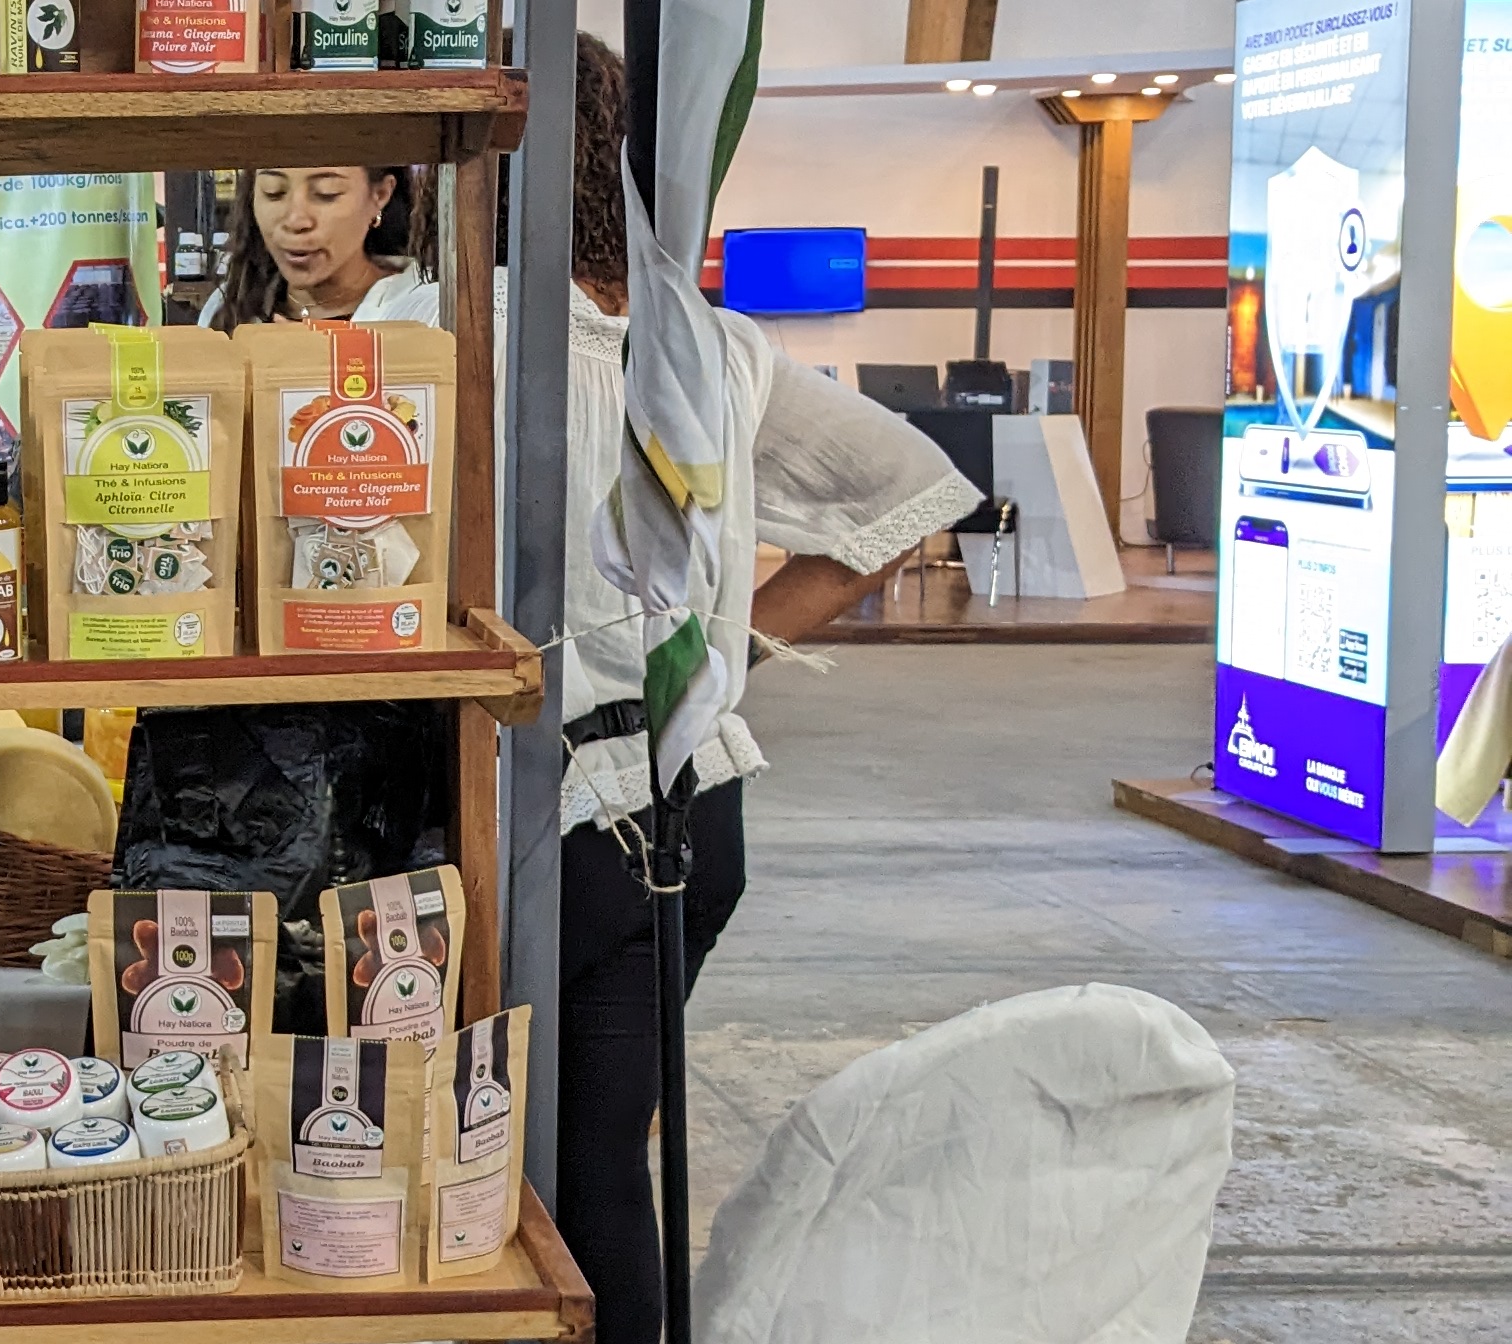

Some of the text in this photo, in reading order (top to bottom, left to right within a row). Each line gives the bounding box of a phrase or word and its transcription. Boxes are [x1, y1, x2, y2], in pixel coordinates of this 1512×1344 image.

[314, 29, 369, 50] Spiruline
[423, 30, 479, 52] Spiruline
[349, 453, 388, 463] Natiora
[110, 459, 169, 471] Hay Natiora
[349, 470, 403, 481] Infusions
[94, 476, 186, 488] Thé Infusions
[293, 482, 421, 495] Curcuma Gingembre
[149, 489, 186, 501] Citron
[325, 495, 392, 508] Poivre Noir
[108, 502, 175, 515] Citronnelle
[174, 949, 194, 963] 100g
[157, 1018, 212, 1030] Hay Natiora
[156, 1038, 190, 1049] Poudre
[312, 1158, 365, 1169] Baobab
